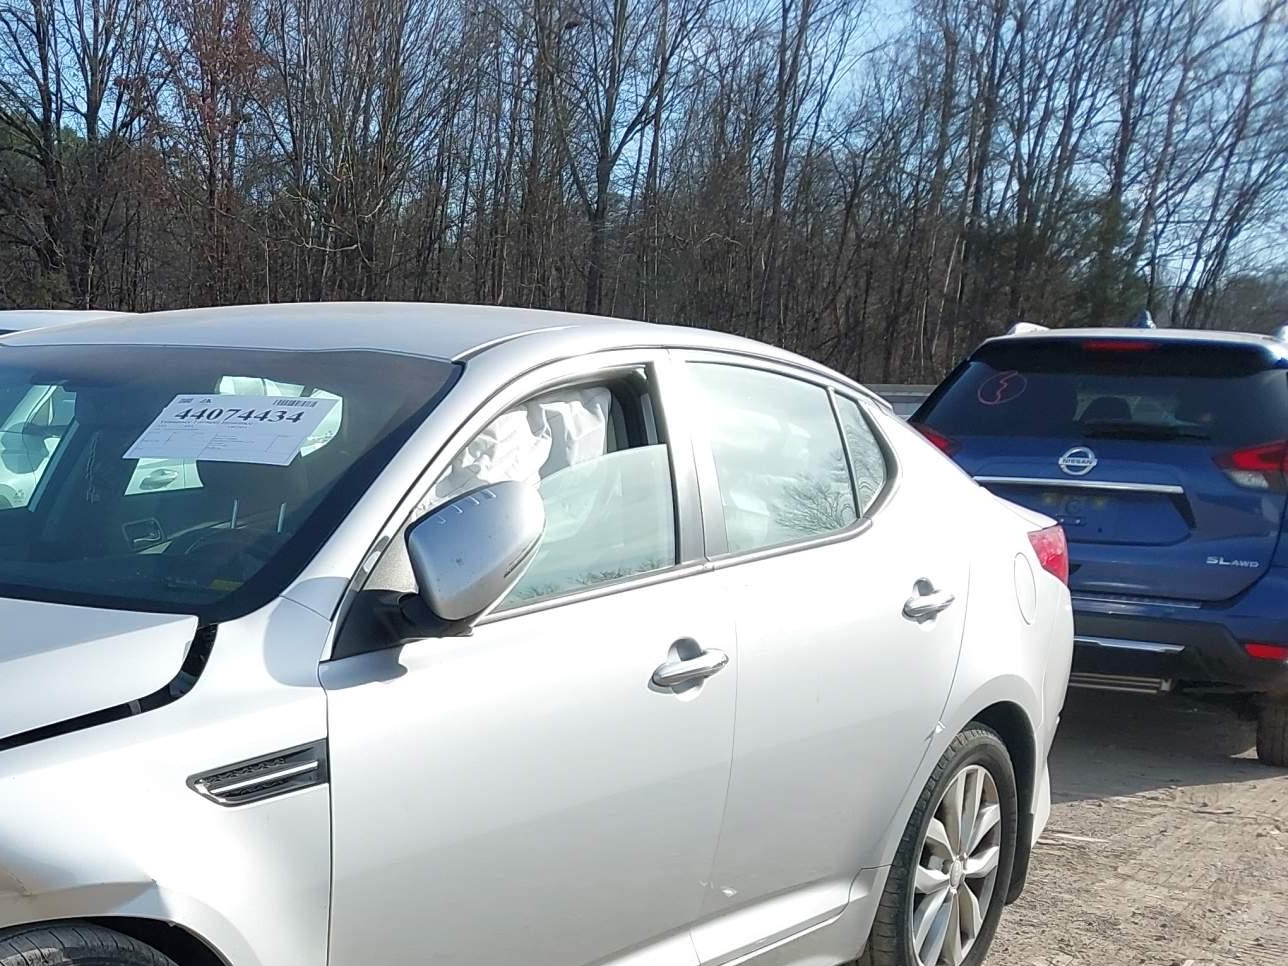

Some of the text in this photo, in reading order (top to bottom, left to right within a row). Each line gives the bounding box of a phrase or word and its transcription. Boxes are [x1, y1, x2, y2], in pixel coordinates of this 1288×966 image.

[175, 408, 305, 423] 44074434
[1206, 556, 1260, 568] SL AWD
